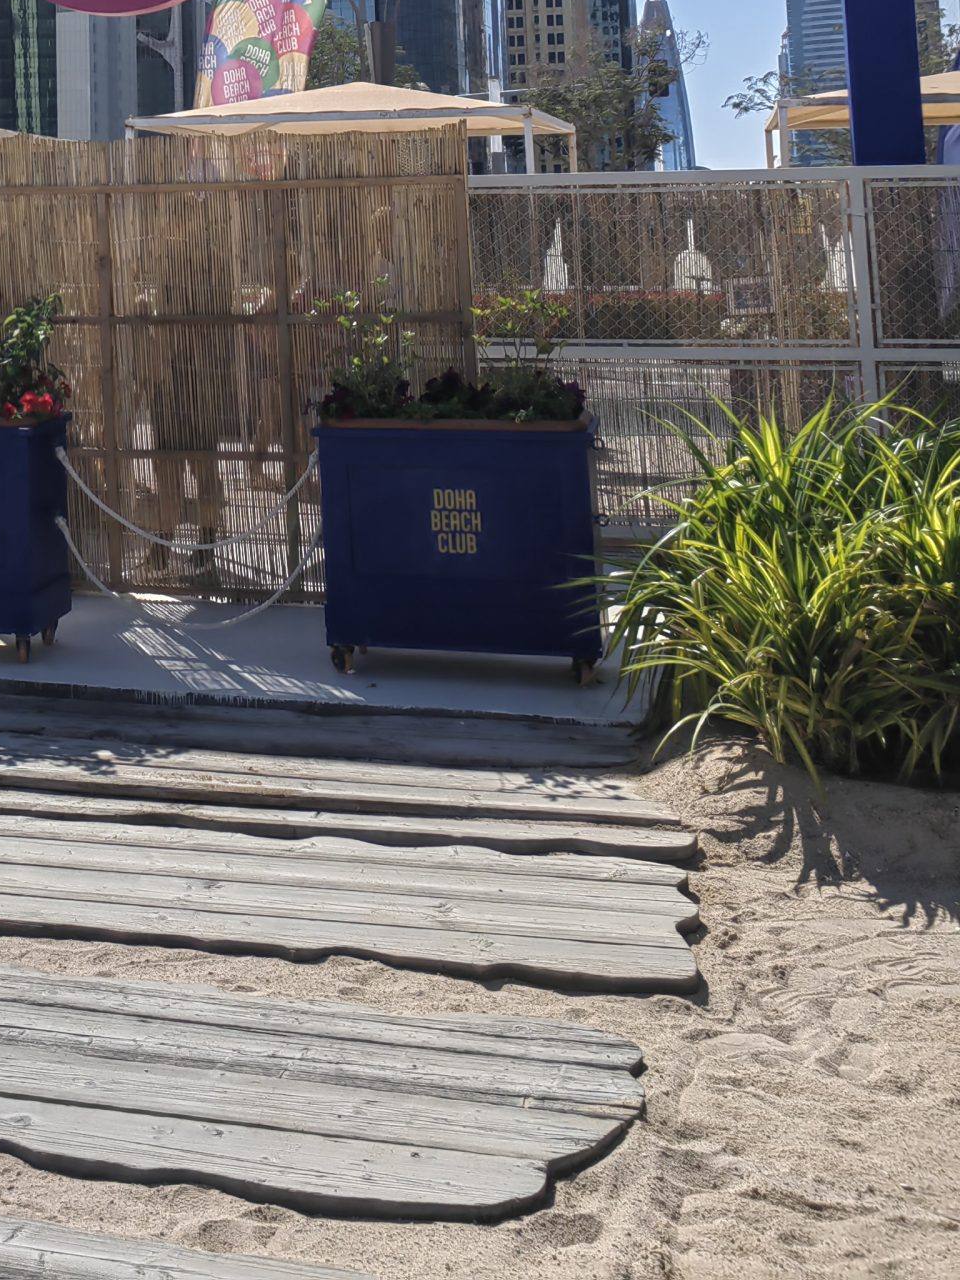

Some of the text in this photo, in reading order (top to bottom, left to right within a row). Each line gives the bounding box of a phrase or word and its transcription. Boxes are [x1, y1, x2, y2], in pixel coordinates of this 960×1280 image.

[255, 5, 275, 23] ACH
[245, 44, 271, 64] DOHA
[277, 37, 298, 54] CLUB
[223, 67, 246, 84] DOHA
[223, 80, 250, 99] BEACH
[434, 489, 476, 510] DOHA
[431, 510, 481, 532] BEACH
[437, 532, 477, 554] CLUB
